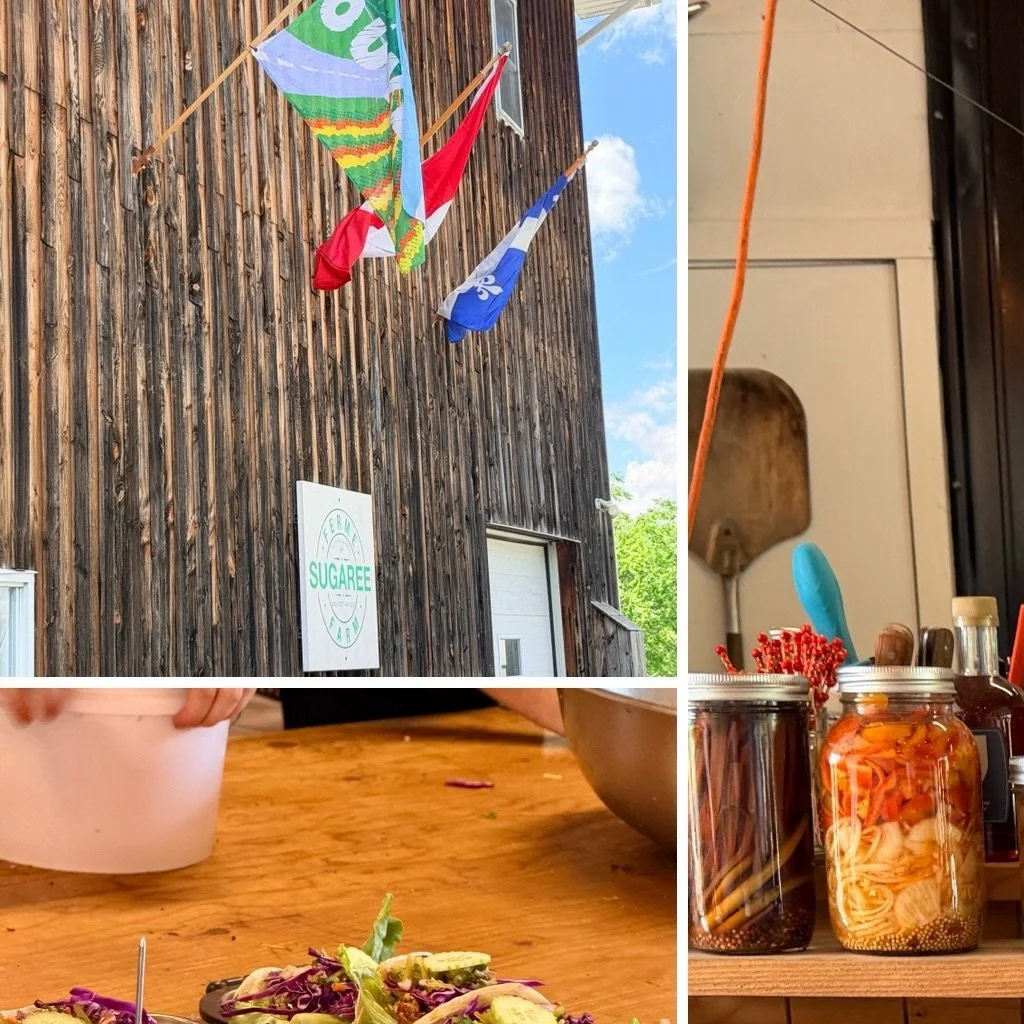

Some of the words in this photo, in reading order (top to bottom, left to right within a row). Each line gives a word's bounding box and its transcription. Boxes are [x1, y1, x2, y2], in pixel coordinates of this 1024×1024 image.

[322, 512, 358, 547] FERME
[308, 559, 372, 592] SUGAREE
[329, 615, 360, 644] FARM
